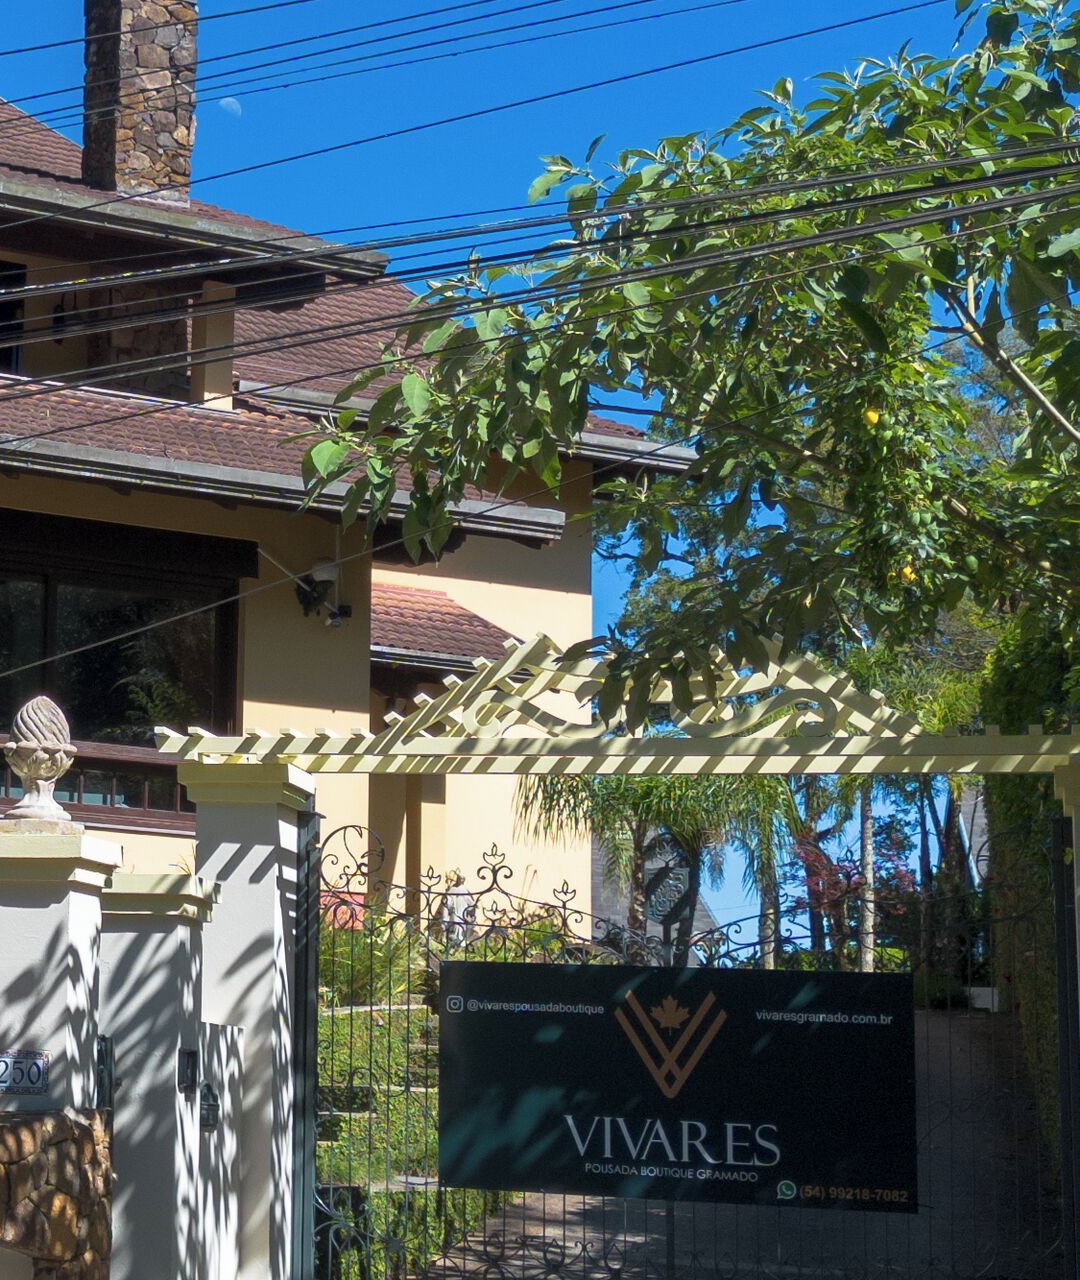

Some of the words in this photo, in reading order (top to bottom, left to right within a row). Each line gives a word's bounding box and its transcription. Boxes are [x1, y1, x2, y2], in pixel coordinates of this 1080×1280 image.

[466, 998, 605, 1015] @vivarespousadaboutique
[755, 1009, 893, 1026] vivaresgramado.com.br
[564, 1114, 781, 1166] VIVARES
[585, 1162, 638, 1176] POUSADA
[640, 1166, 694, 1180] BOUTIQUE
[696, 1168, 758, 1183] GRAMADO
[799, 1185, 826, 1201] (54)
[828, 1186, 908, 1203] 99218-7082
